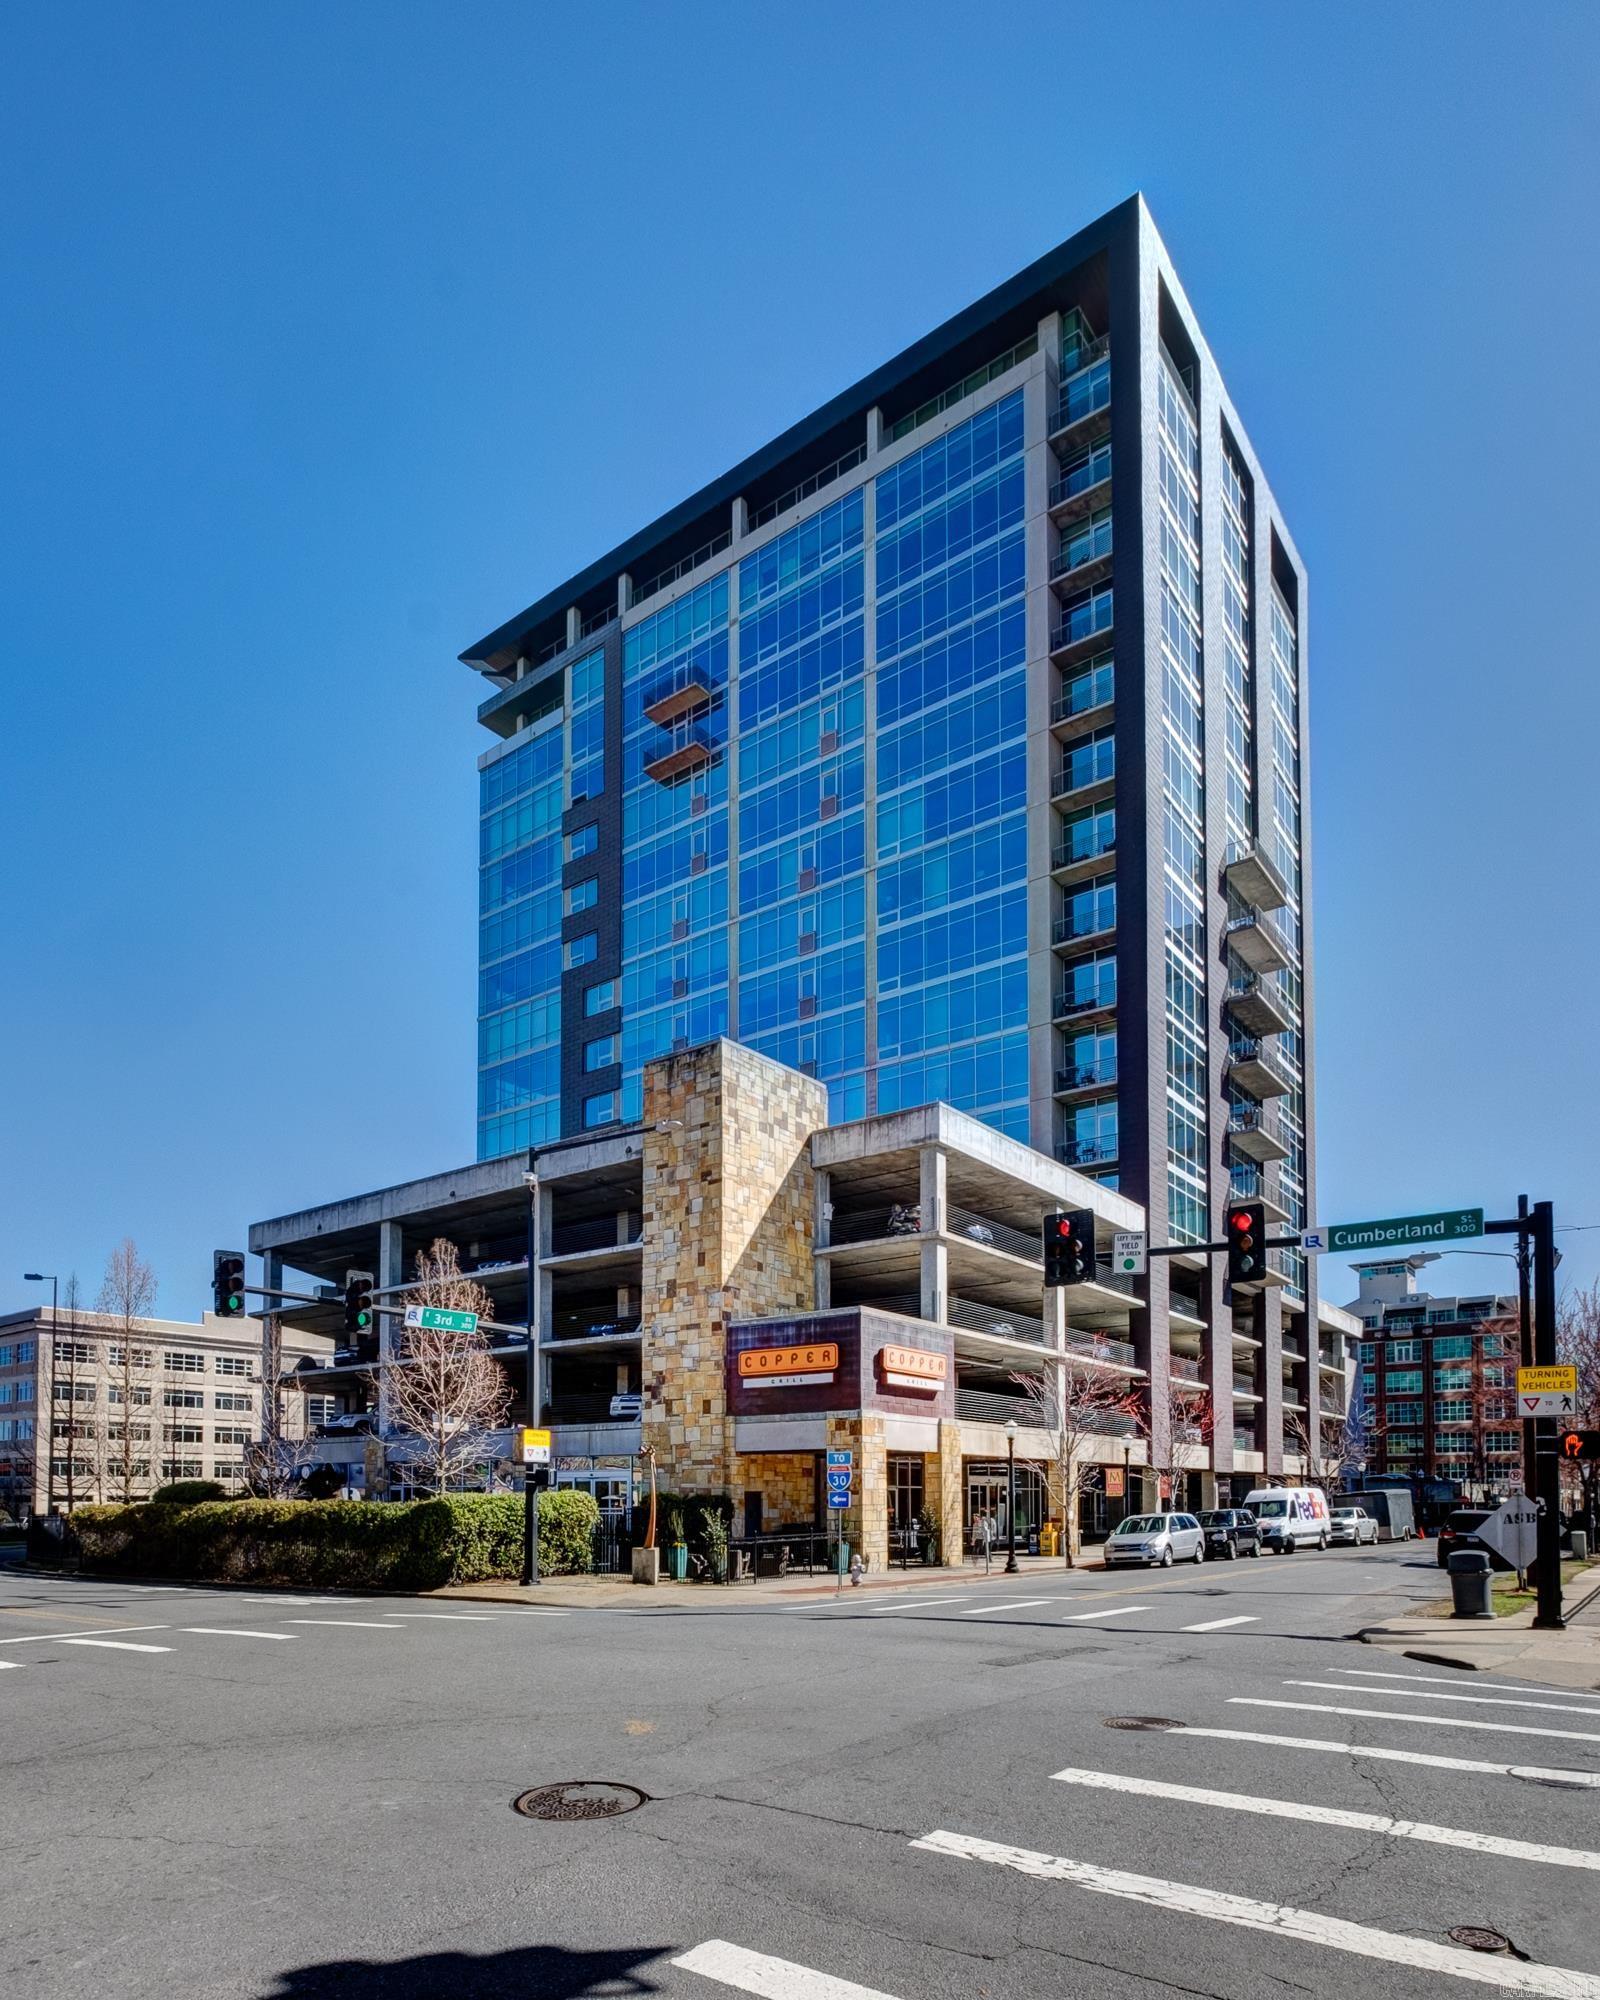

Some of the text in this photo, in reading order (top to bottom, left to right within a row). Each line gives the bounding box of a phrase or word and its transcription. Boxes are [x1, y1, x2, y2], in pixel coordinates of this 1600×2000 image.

[1335, 1220, 1445, 1245] Cumberland
[1454, 1223, 1476, 1234] 300
[744, 1350, 831, 1369] COPPER
[889, 1351, 944, 1372] COPPER
[1524, 1369, 1570, 1379] TURNING
[771, 1377, 804, 1385] GRILL
[1521, 1380, 1573, 1390] VEHICLES
[833, 1454, 845, 1463] TO
[832, 1475, 847, 1487] 30
[1294, 1492, 1326, 1520] FedEx
[1503, 1512, 1536, 1525] ASB
